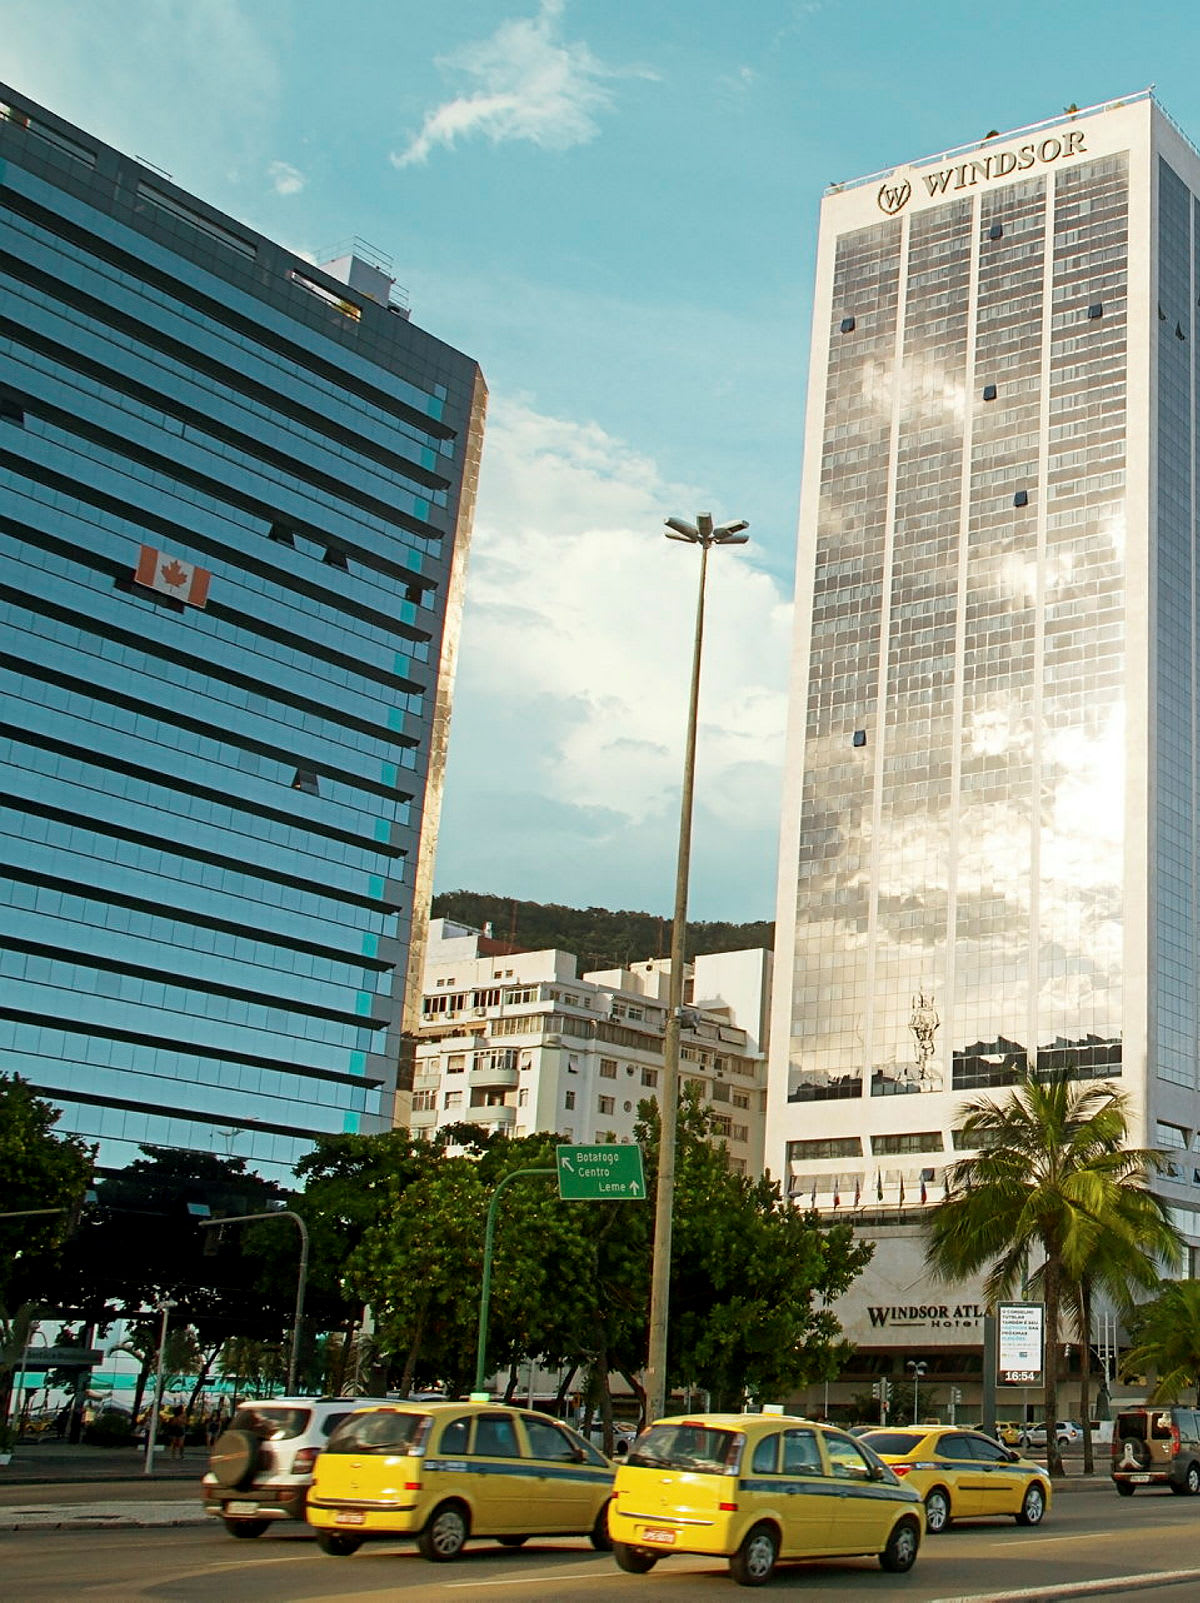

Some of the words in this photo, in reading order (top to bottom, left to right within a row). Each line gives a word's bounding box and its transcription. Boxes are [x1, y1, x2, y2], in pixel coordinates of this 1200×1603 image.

[922, 130, 1088, 197] WINDSOR
[576, 1152, 619, 1165] Botafogo
[578, 1167, 610, 1177] Centro
[599, 1182, 626, 1192] Leme
[867, 1305, 949, 1328] WINDSOR
[931, 1320, 978, 1328] Hotel
[1005, 1371, 1035, 1381] 16:54
